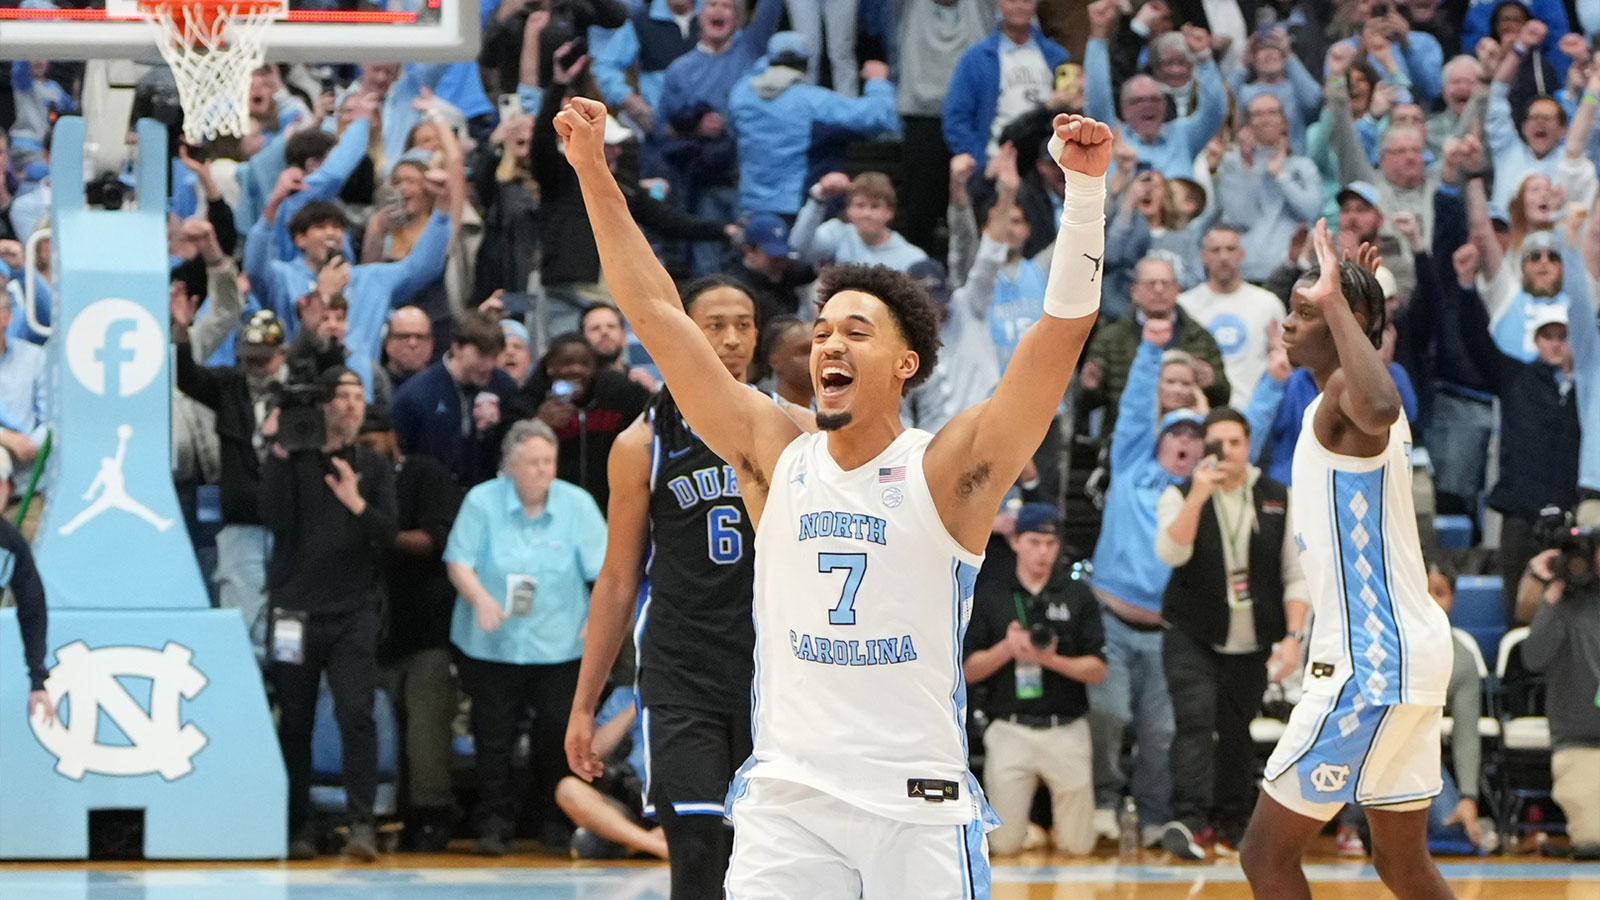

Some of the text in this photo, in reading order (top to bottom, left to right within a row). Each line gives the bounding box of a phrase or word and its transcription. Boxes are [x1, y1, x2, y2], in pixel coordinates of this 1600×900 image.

[667, 464, 743, 509] DUK
[706, 505, 743, 565] 6
[799, 510, 887, 546] NORTH
[818, 552, 867, 625] 7
[789, 629, 918, 666] CAROLINA
